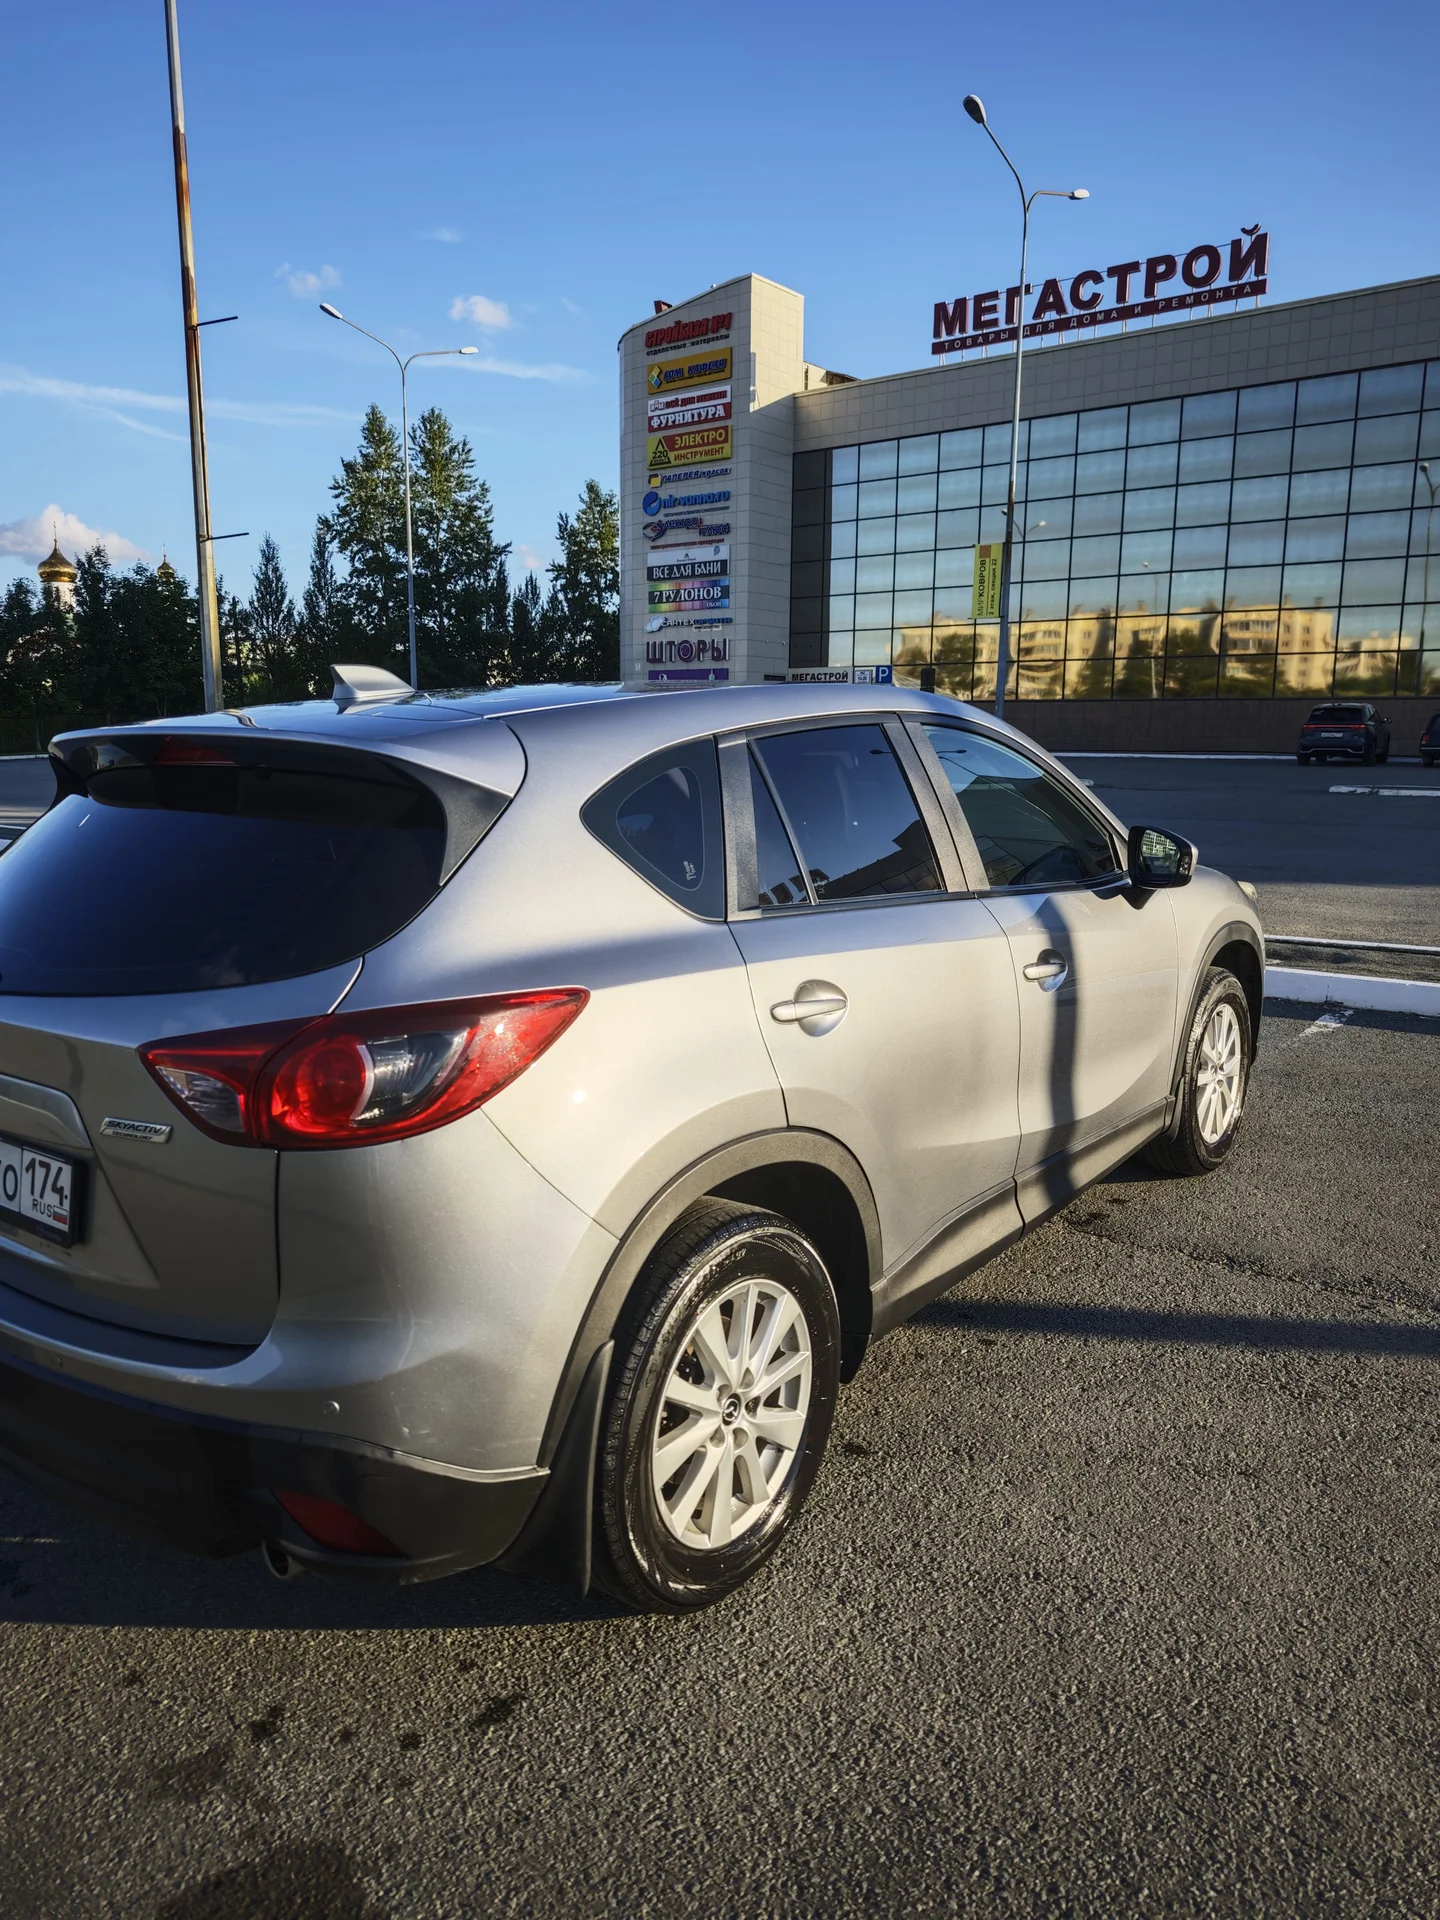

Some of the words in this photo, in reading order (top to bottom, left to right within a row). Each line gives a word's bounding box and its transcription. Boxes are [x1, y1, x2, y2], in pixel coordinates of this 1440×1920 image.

[933, 223, 1270, 339] МЕГАСТРОЙ
[944, 331, 1009, 350] ТОВАРЫ
[1023, 322, 1055, 337] ДЛЯ
[1069, 310, 1118, 327] ДОМА
[1134, 305, 1142, 315] И
[1158, 285, 1252, 310] РЕМОНТА
[645, 318, 708, 348] СТРОЙБАЗА
[646, 343, 687, 356] отделочные
[651, 405, 726, 428] ФУРНИТУРА
[674, 429, 726, 449] ЭЛЕКТРО
[652, 449, 669, 459] 220
[674, 446, 725, 461] ИНСТРУМЕНТ
[653, 566, 670, 579] ВСЕ
[671, 564, 692, 577] ДЛЯ
[695, 561, 721, 575] БАНИ
[992, 558, 997, 567] 22
[653, 591, 660, 603] 7
[662, 586, 722, 603] РУЛОНОВ
[646, 638, 729, 663] ШТОРЫ
[791, 671, 848, 682] МЕГАСТРОЙ
[879, 667, 889, 682] P
[107, 1120, 163, 1134] SKYACTIV
[112, 1131, 154, 1141] TECHNOLOGY
[25, 1157, 65, 1207] 174
[32, 1198, 53, 1218] RUS
